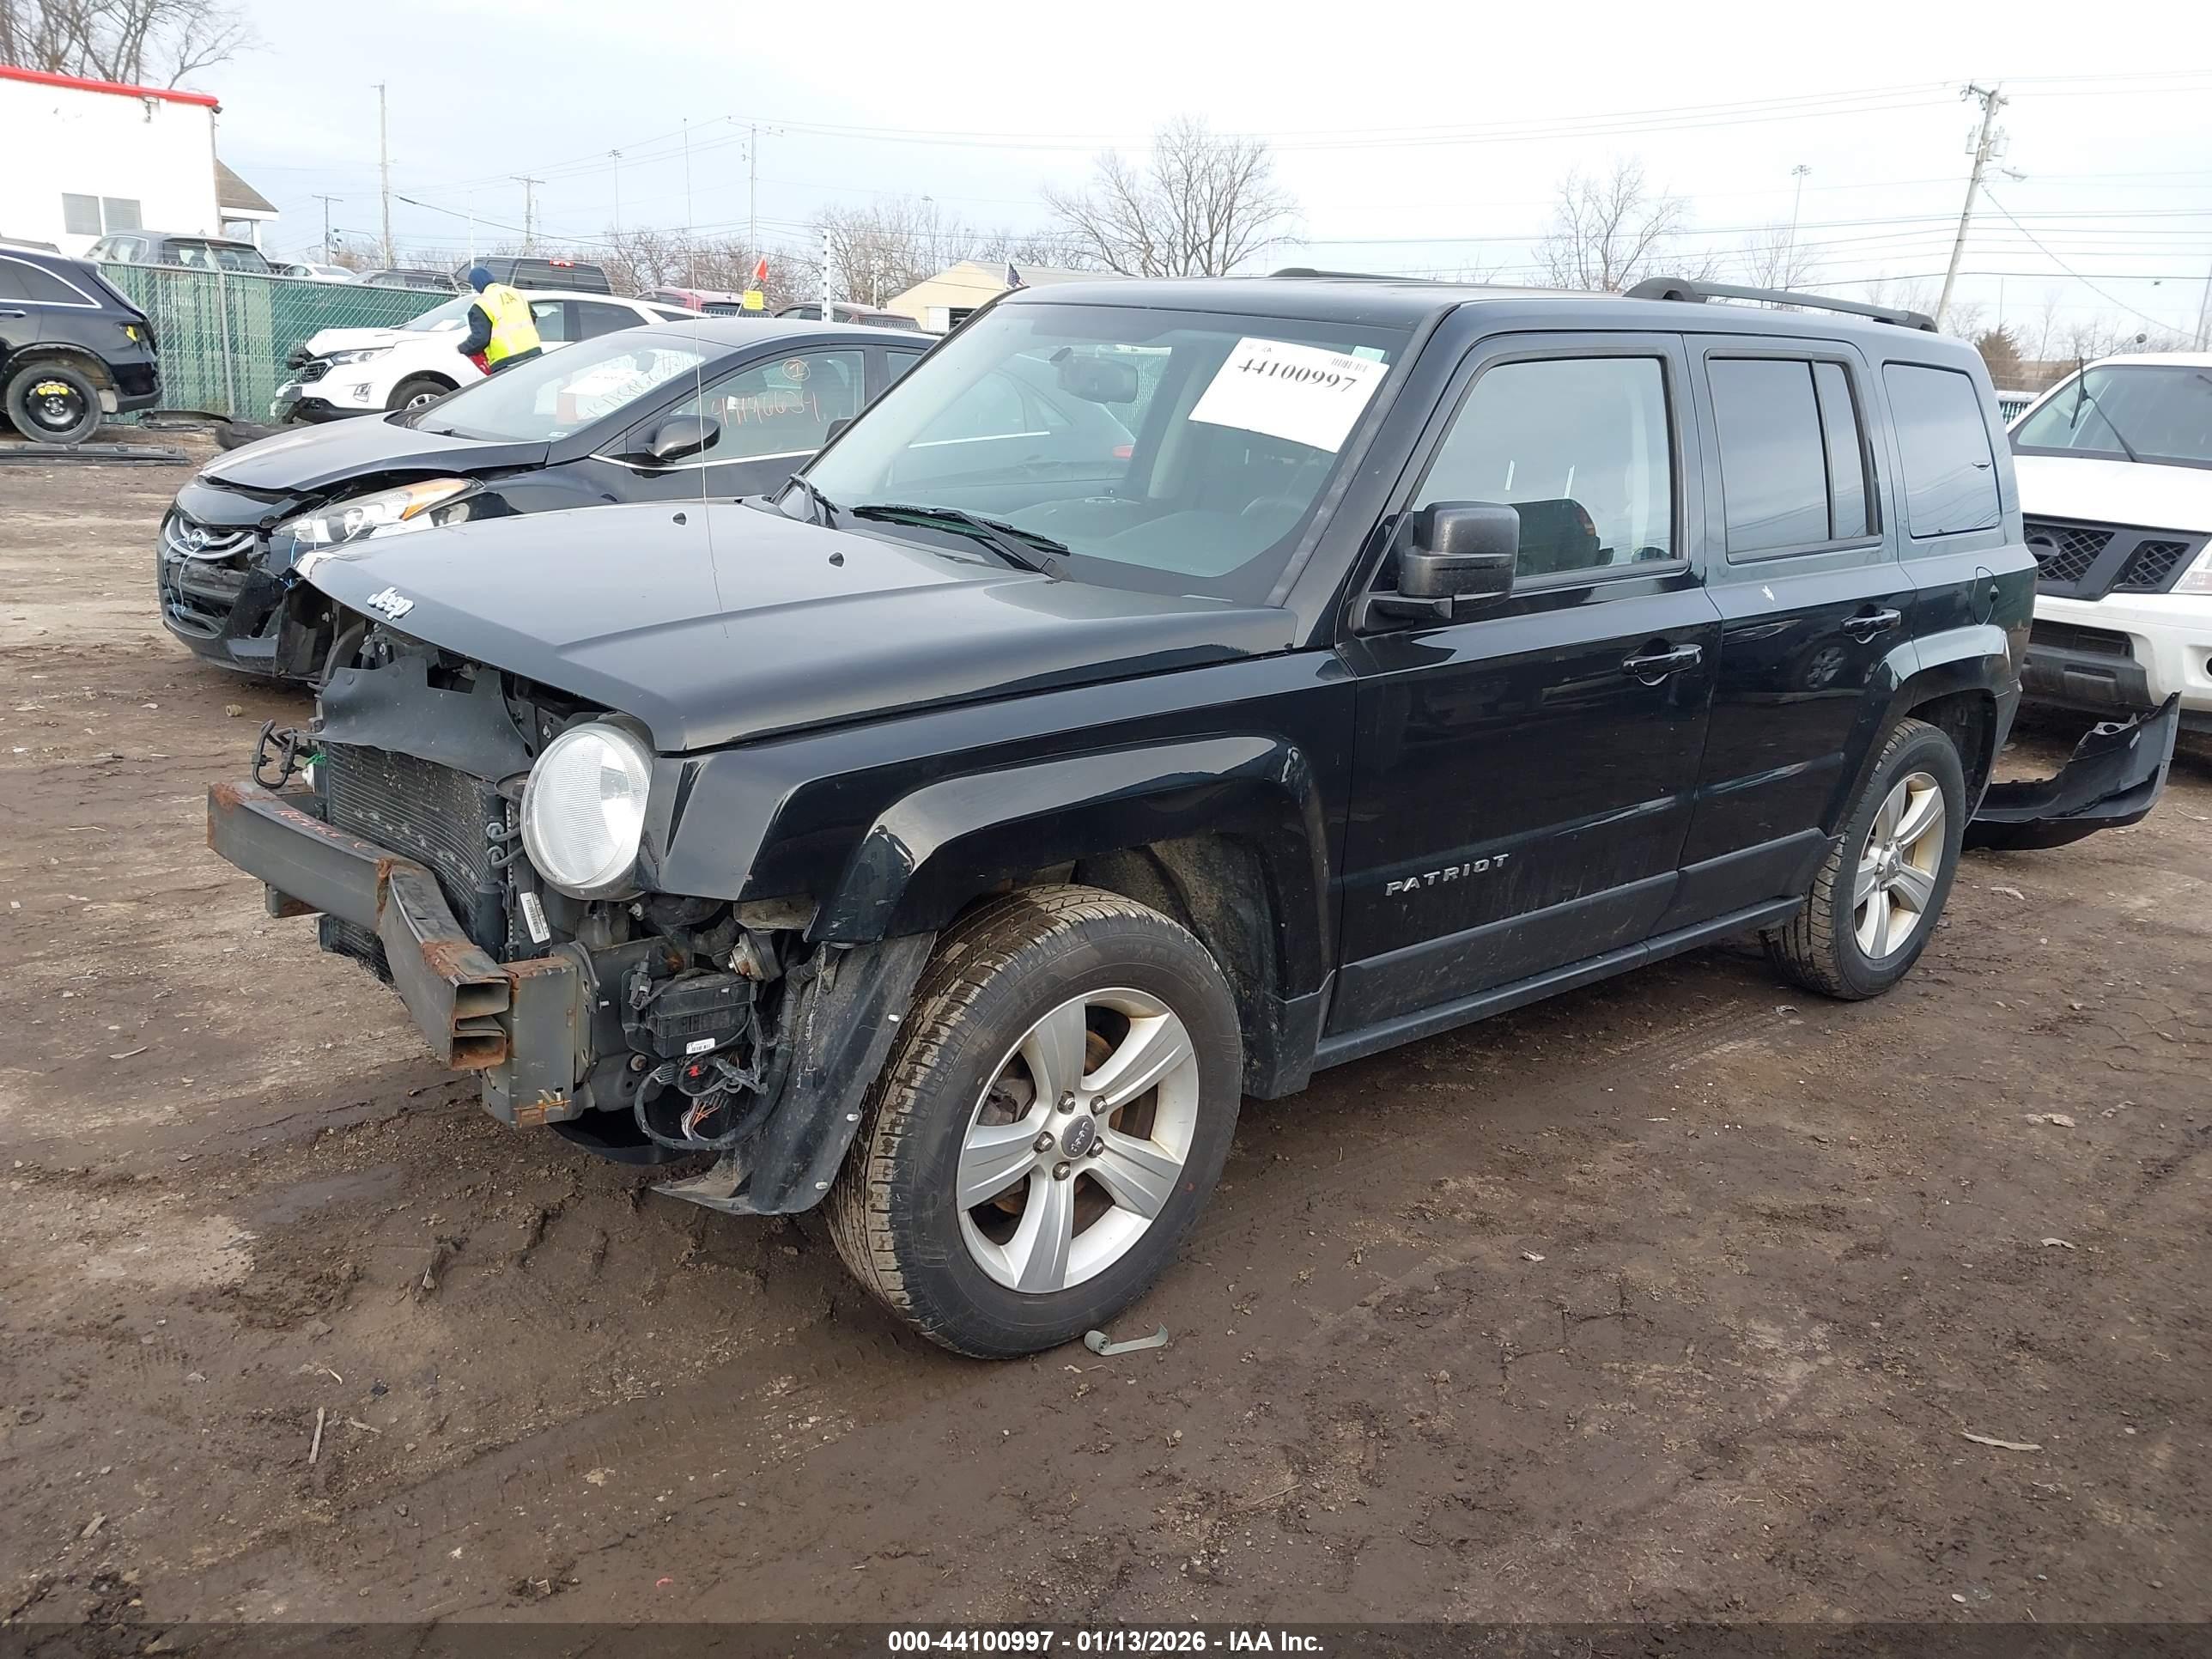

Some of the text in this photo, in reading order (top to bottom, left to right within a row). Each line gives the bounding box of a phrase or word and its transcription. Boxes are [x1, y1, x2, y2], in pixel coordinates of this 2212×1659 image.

[1237, 358, 1358, 392] 44100997
[367, 586, 415, 621] Jeep
[1384, 853, 1511, 896] PATRIOT
